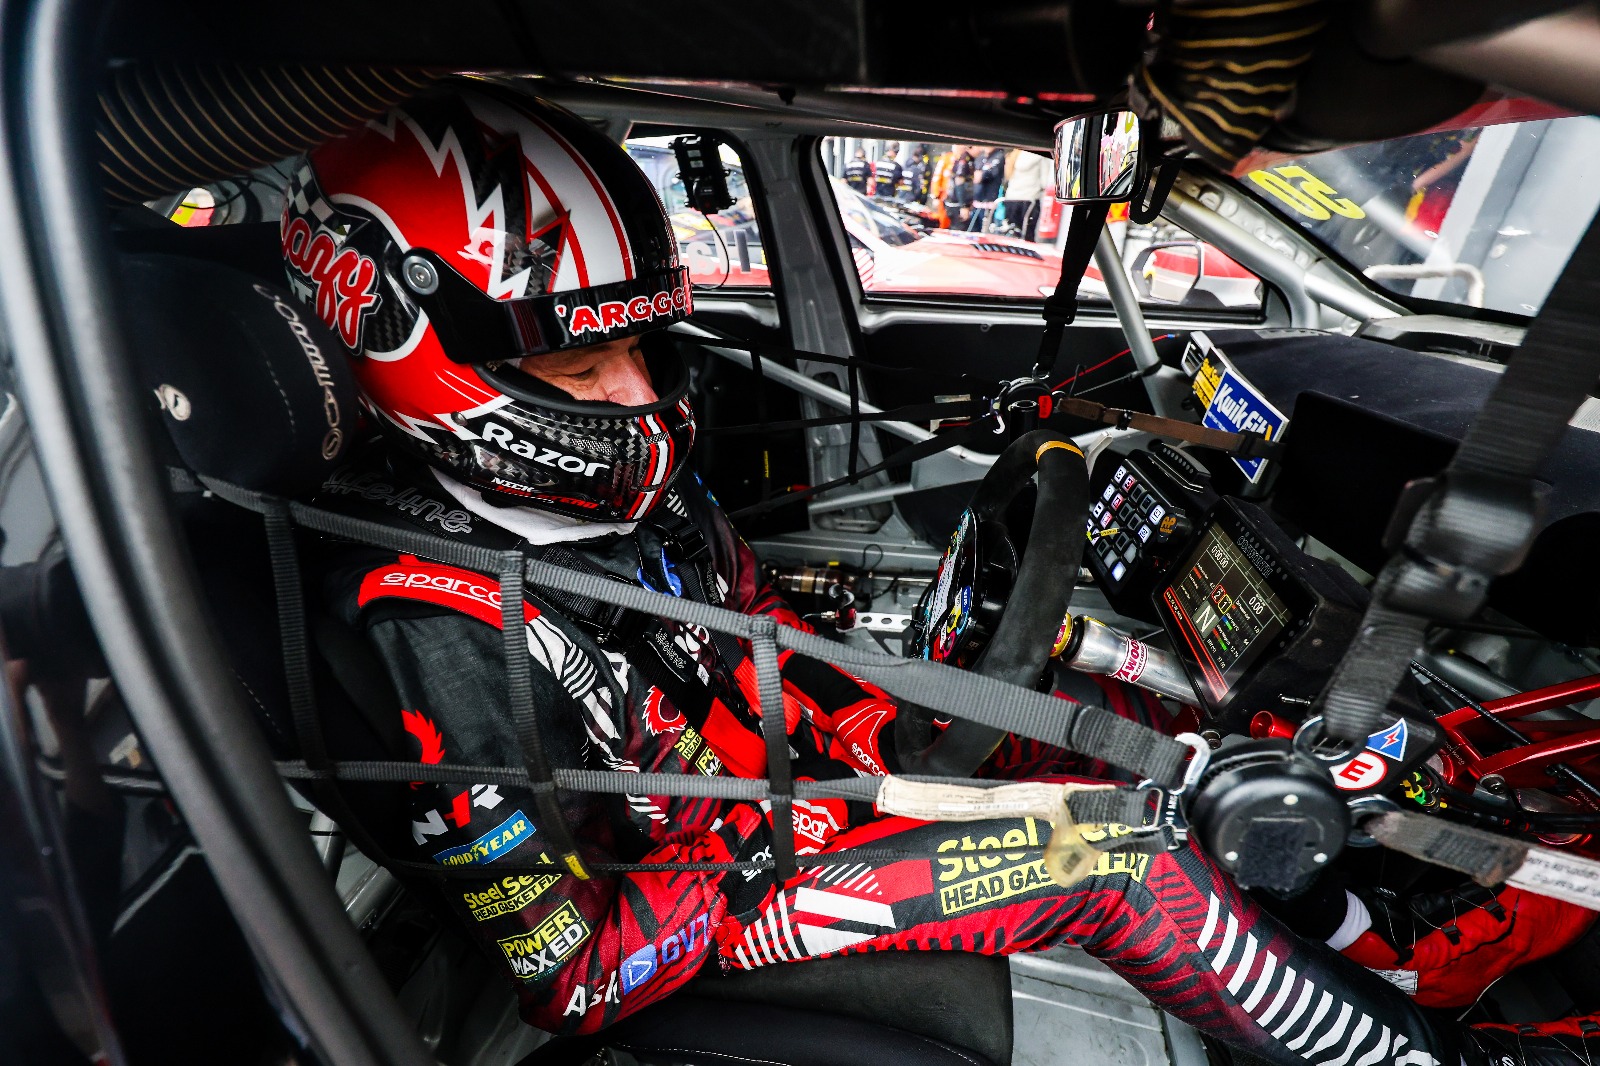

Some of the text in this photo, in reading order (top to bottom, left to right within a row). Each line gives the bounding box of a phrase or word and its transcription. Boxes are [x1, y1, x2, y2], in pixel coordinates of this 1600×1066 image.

[481, 421, 611, 477] Razor
[491, 476, 535, 493] NICK
[1196, 605, 1217, 633] N
[1338, 758, 1374, 782] E
[937, 816, 1039, 882] Steel
[463, 882, 505, 909] Steel
[474, 906, 498, 920] HEAD
[498, 885, 538, 913] GASKET
[943, 876, 1005, 912] HEAD
[502, 909, 576, 958] POWER
[510, 923, 583, 975] MAXED
[563, 969, 620, 1017] Ask
